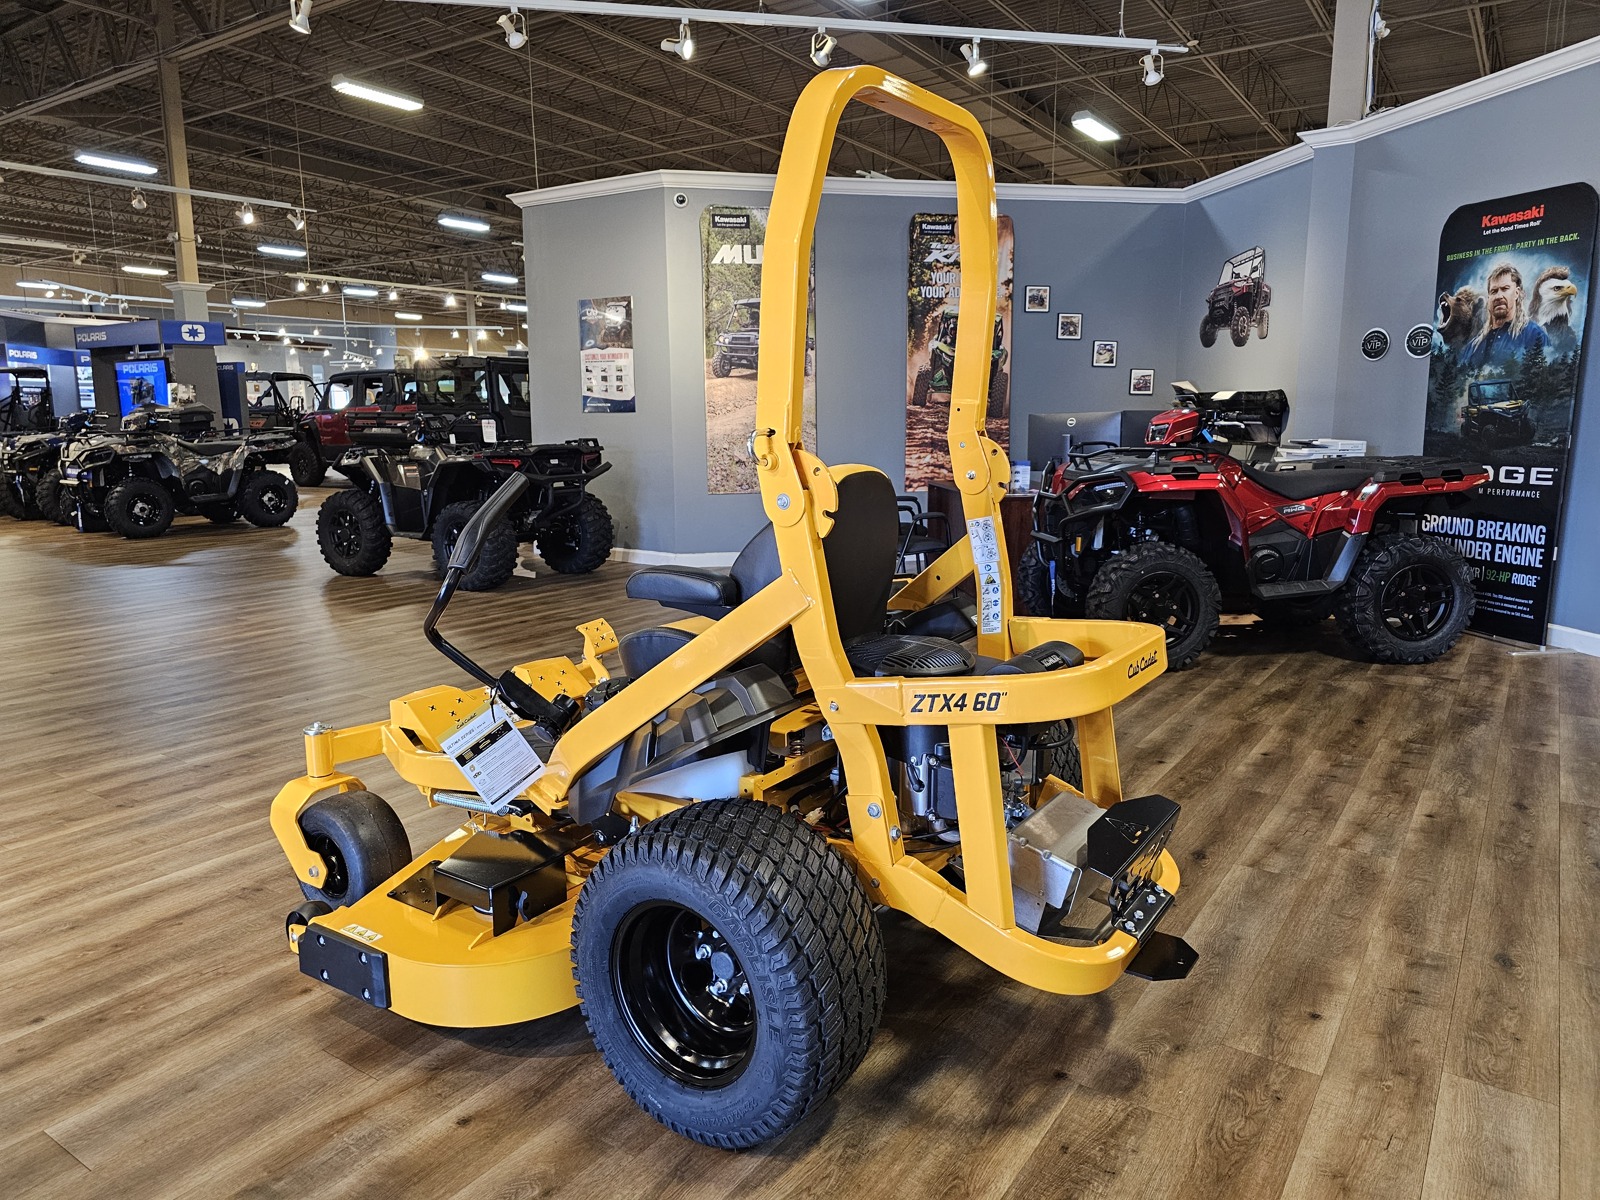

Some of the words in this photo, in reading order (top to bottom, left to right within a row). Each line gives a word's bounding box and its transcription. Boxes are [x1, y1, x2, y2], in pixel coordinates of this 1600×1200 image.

[714, 215, 747, 223] Kawasaki
[1481, 204, 1545, 227] Kawasaki
[921, 223, 952, 231] Kawasaki
[1483, 228, 1491, 236] Let
[1500, 224, 1514, 232] Good
[1514, 222, 1529, 230] Times
[1446, 250, 1473, 262] BUSINESS
[1473, 249, 1481, 257] IN
[1481, 246, 1493, 255] THE
[1493, 243, 1515, 254] FRONT.
[1515, 240, 1537, 250] PARTY
[1537, 238, 1545, 247] IN
[1546, 235, 1558, 245] THE
[1559, 232, 1580, 243] BACK.
[711, 244, 763, 265] MU
[931, 271, 956, 284] YOUR
[920, 285, 946, 298] YOUR
[77, 331, 107, 343] POLARIS
[1412, 338, 1428, 347] VIP
[1367, 341, 1381, 350] VIP
[8, 349, 38, 360] POLARIS
[122, 362, 159, 374] POLARIS
[1487, 488, 1541, 499] PERFORMANCE
[1421, 513, 1474, 537] GROUND
[1476, 519, 1547, 546] BREAKING
[1494, 543, 1545, 568] ENGINE
[1485, 569, 1511, 583] 92-HP
[1511, 572, 1538, 588] RIDGE
[1127, 661, 1139, 679] Cub
[1139, 650, 1158, 672] Cadet
[910, 692, 968, 713] ZTX4
[972, 691, 1008, 712] 60"
[707, 900, 783, 1045] CARLISLE
